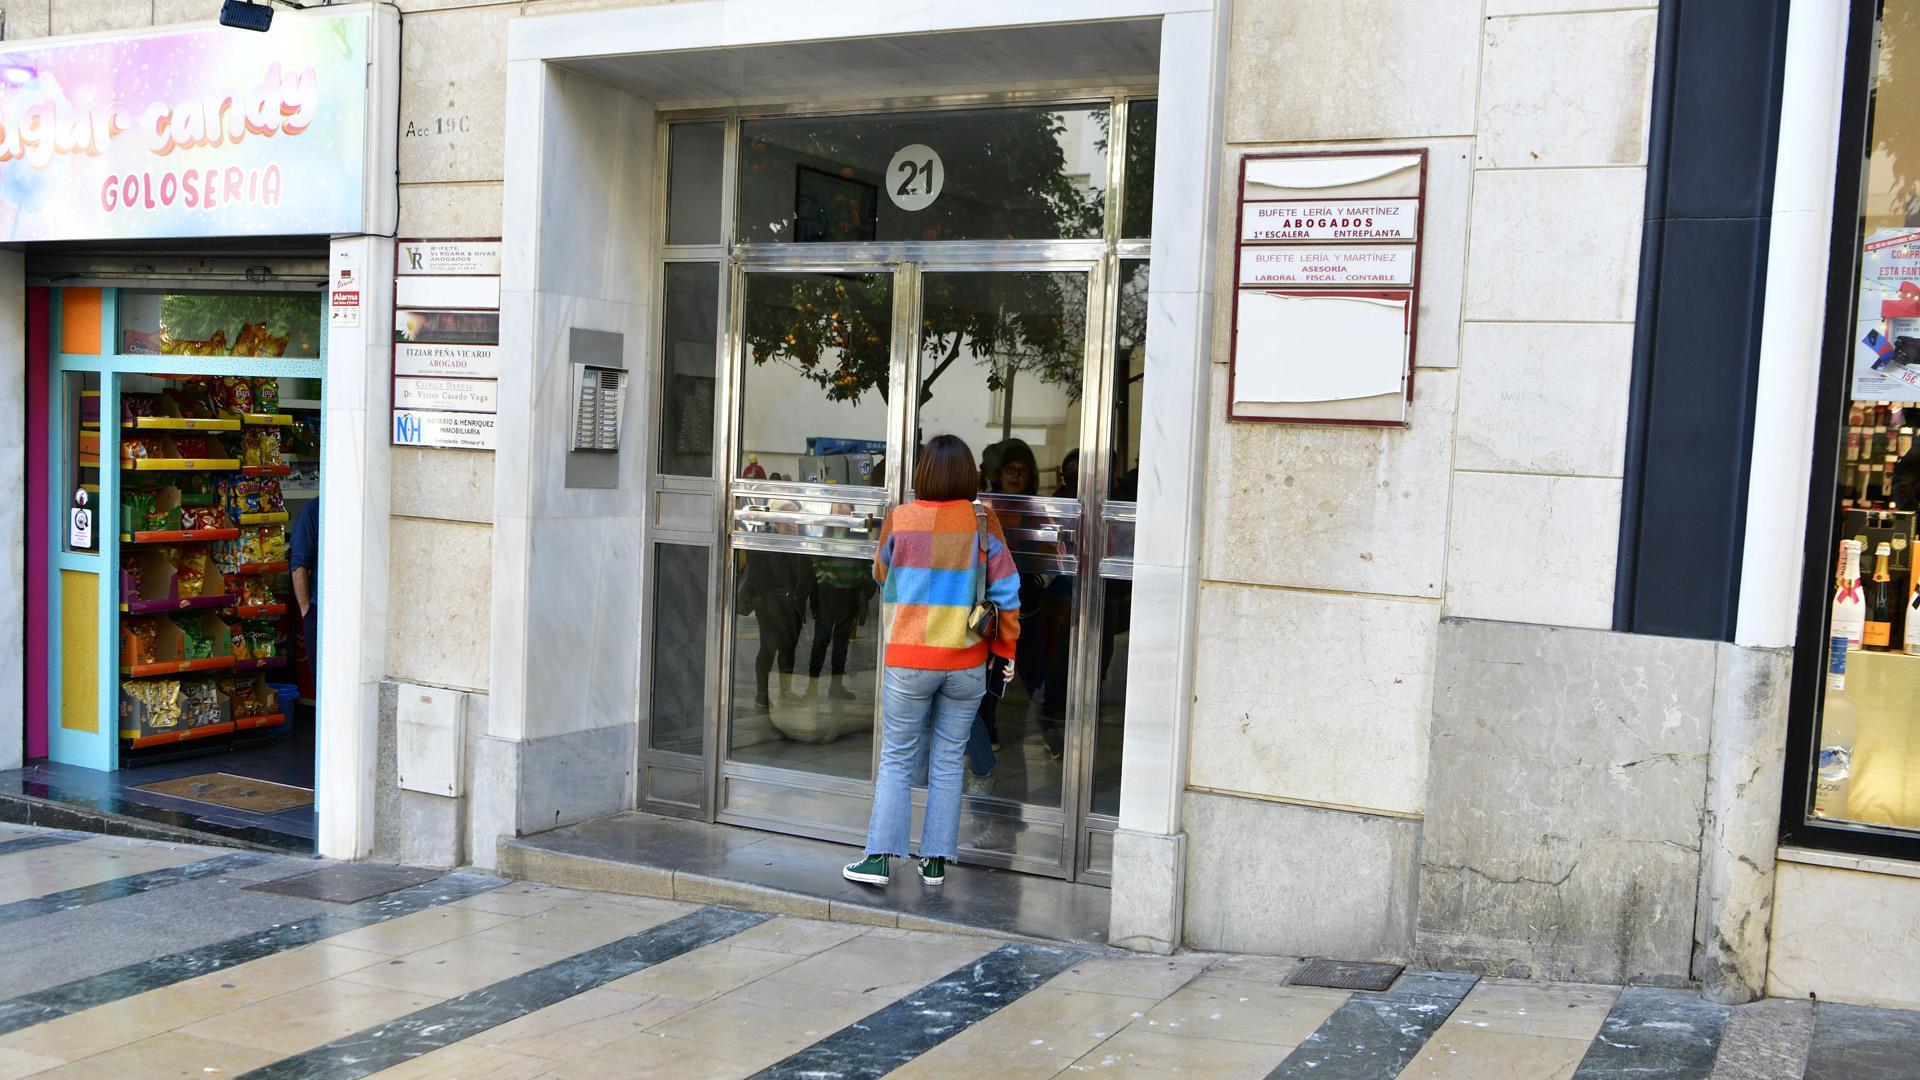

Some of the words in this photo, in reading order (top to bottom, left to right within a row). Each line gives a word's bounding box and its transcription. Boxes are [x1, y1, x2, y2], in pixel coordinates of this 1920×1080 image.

[144, 61, 317, 157] candy
[896, 159, 934, 195] 21
[101, 164, 281, 212] GOLOSERIA
[1258, 208, 1298, 217] BUFETE
[1303, 206, 1333, 217] LERÍA
[1337, 208, 1344, 216] Y
[1346, 205, 1400, 216] MARTÍNEZ
[1283, 218, 1373, 228] ABOGADOS
[1334, 229, 1401, 237] ENTREPLANTA
[1256, 254, 1295, 262] BUFETE
[1300, 252, 1330, 262] LERÍA
[1343, 252, 1397, 262] MARTÍNEZ
[1879, 267, 1899, 276] ESTA
[334, 292, 358, 301] Alarma
[406, 348, 433, 357] ITZIAR
[434, 347, 455, 358] PEÑA
[457, 350, 491, 358] VICARIO
[430, 360, 467, 368] ABOGADO
